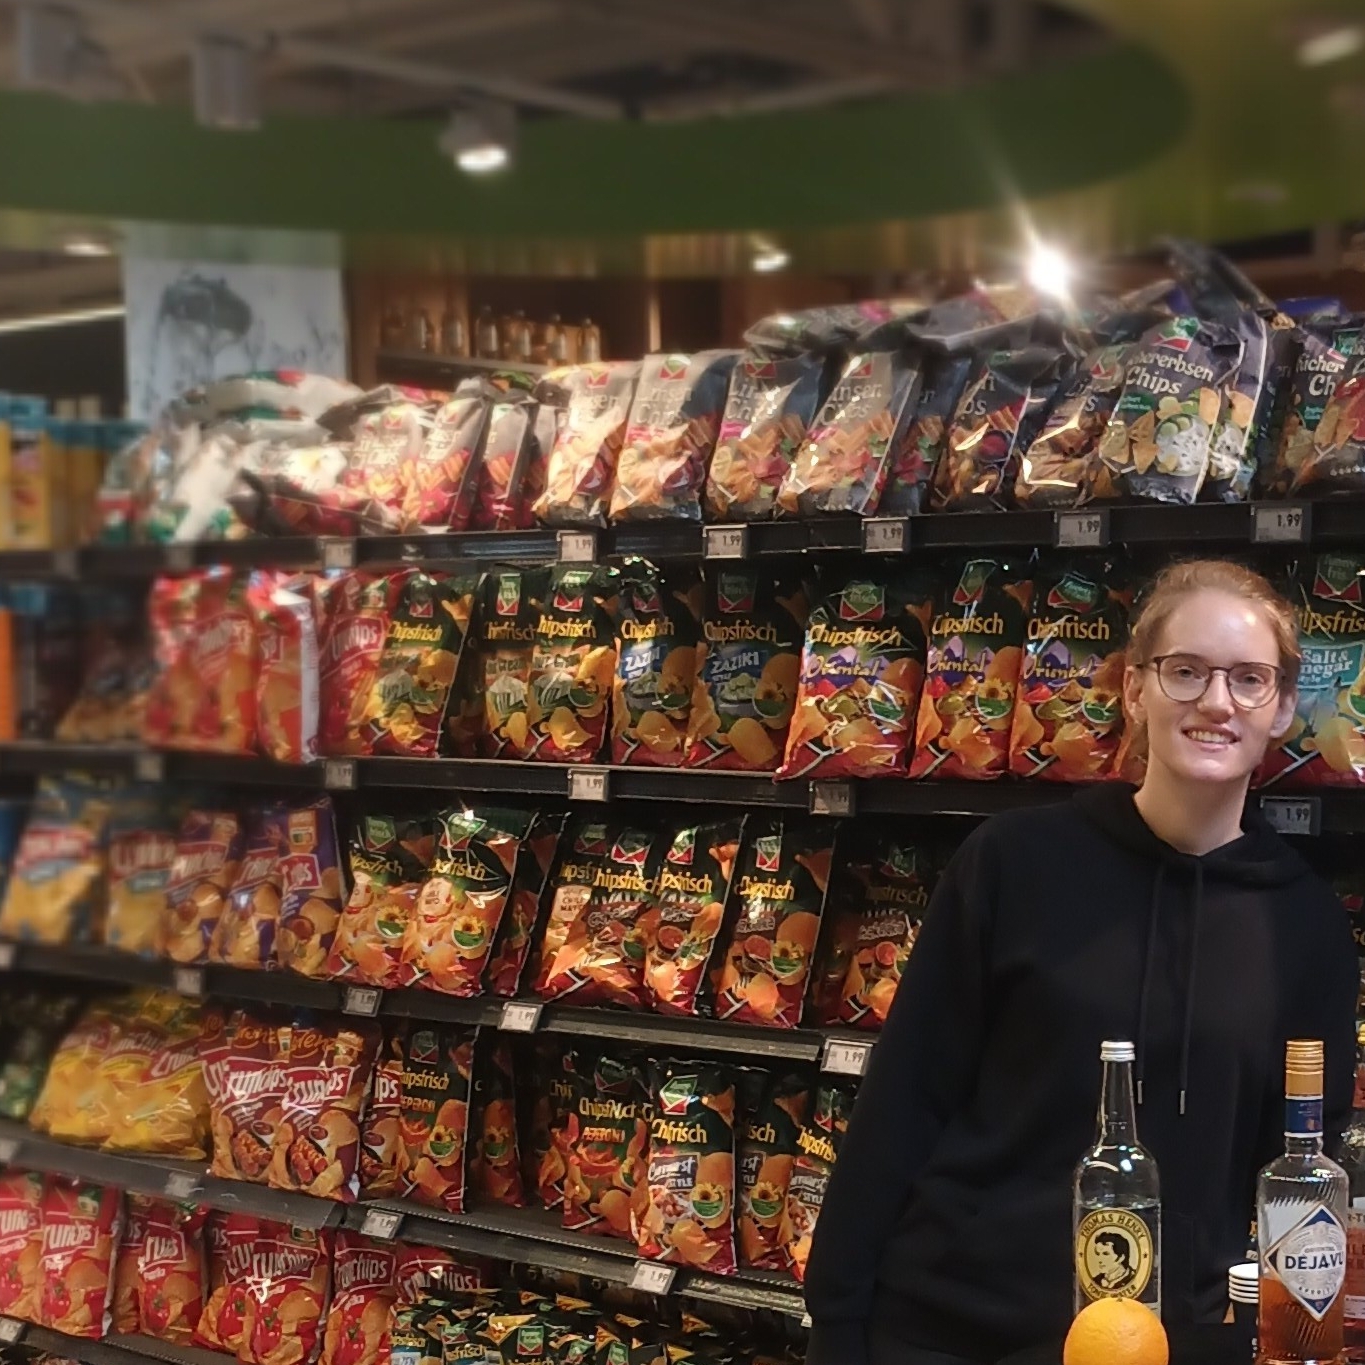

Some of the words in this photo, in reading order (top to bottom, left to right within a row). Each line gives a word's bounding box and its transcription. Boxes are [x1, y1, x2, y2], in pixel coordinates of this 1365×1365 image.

[1126, 366, 1183, 394] Chips
[1077, 521, 1101, 533] 1.99
[1277, 515, 1301, 527] 1.99
[722, 534, 741, 545] 1.99
[883, 529, 901, 539] 1.99
[538, 615, 597, 639] hipsfrisch
[703, 620, 777, 643] Chipsfrisch
[808, 623, 903, 647] Chipsfrisch
[712, 651, 760, 674] ZAZIKI
[1286, 808, 1310, 821] 1.99
[595, 867, 658, 894] hipsfrisch
[844, 1051, 864, 1063] 1.99
[1080, 1213, 1114, 1238] THOMAS
[1117, 1214, 1146, 1238] HENRY
